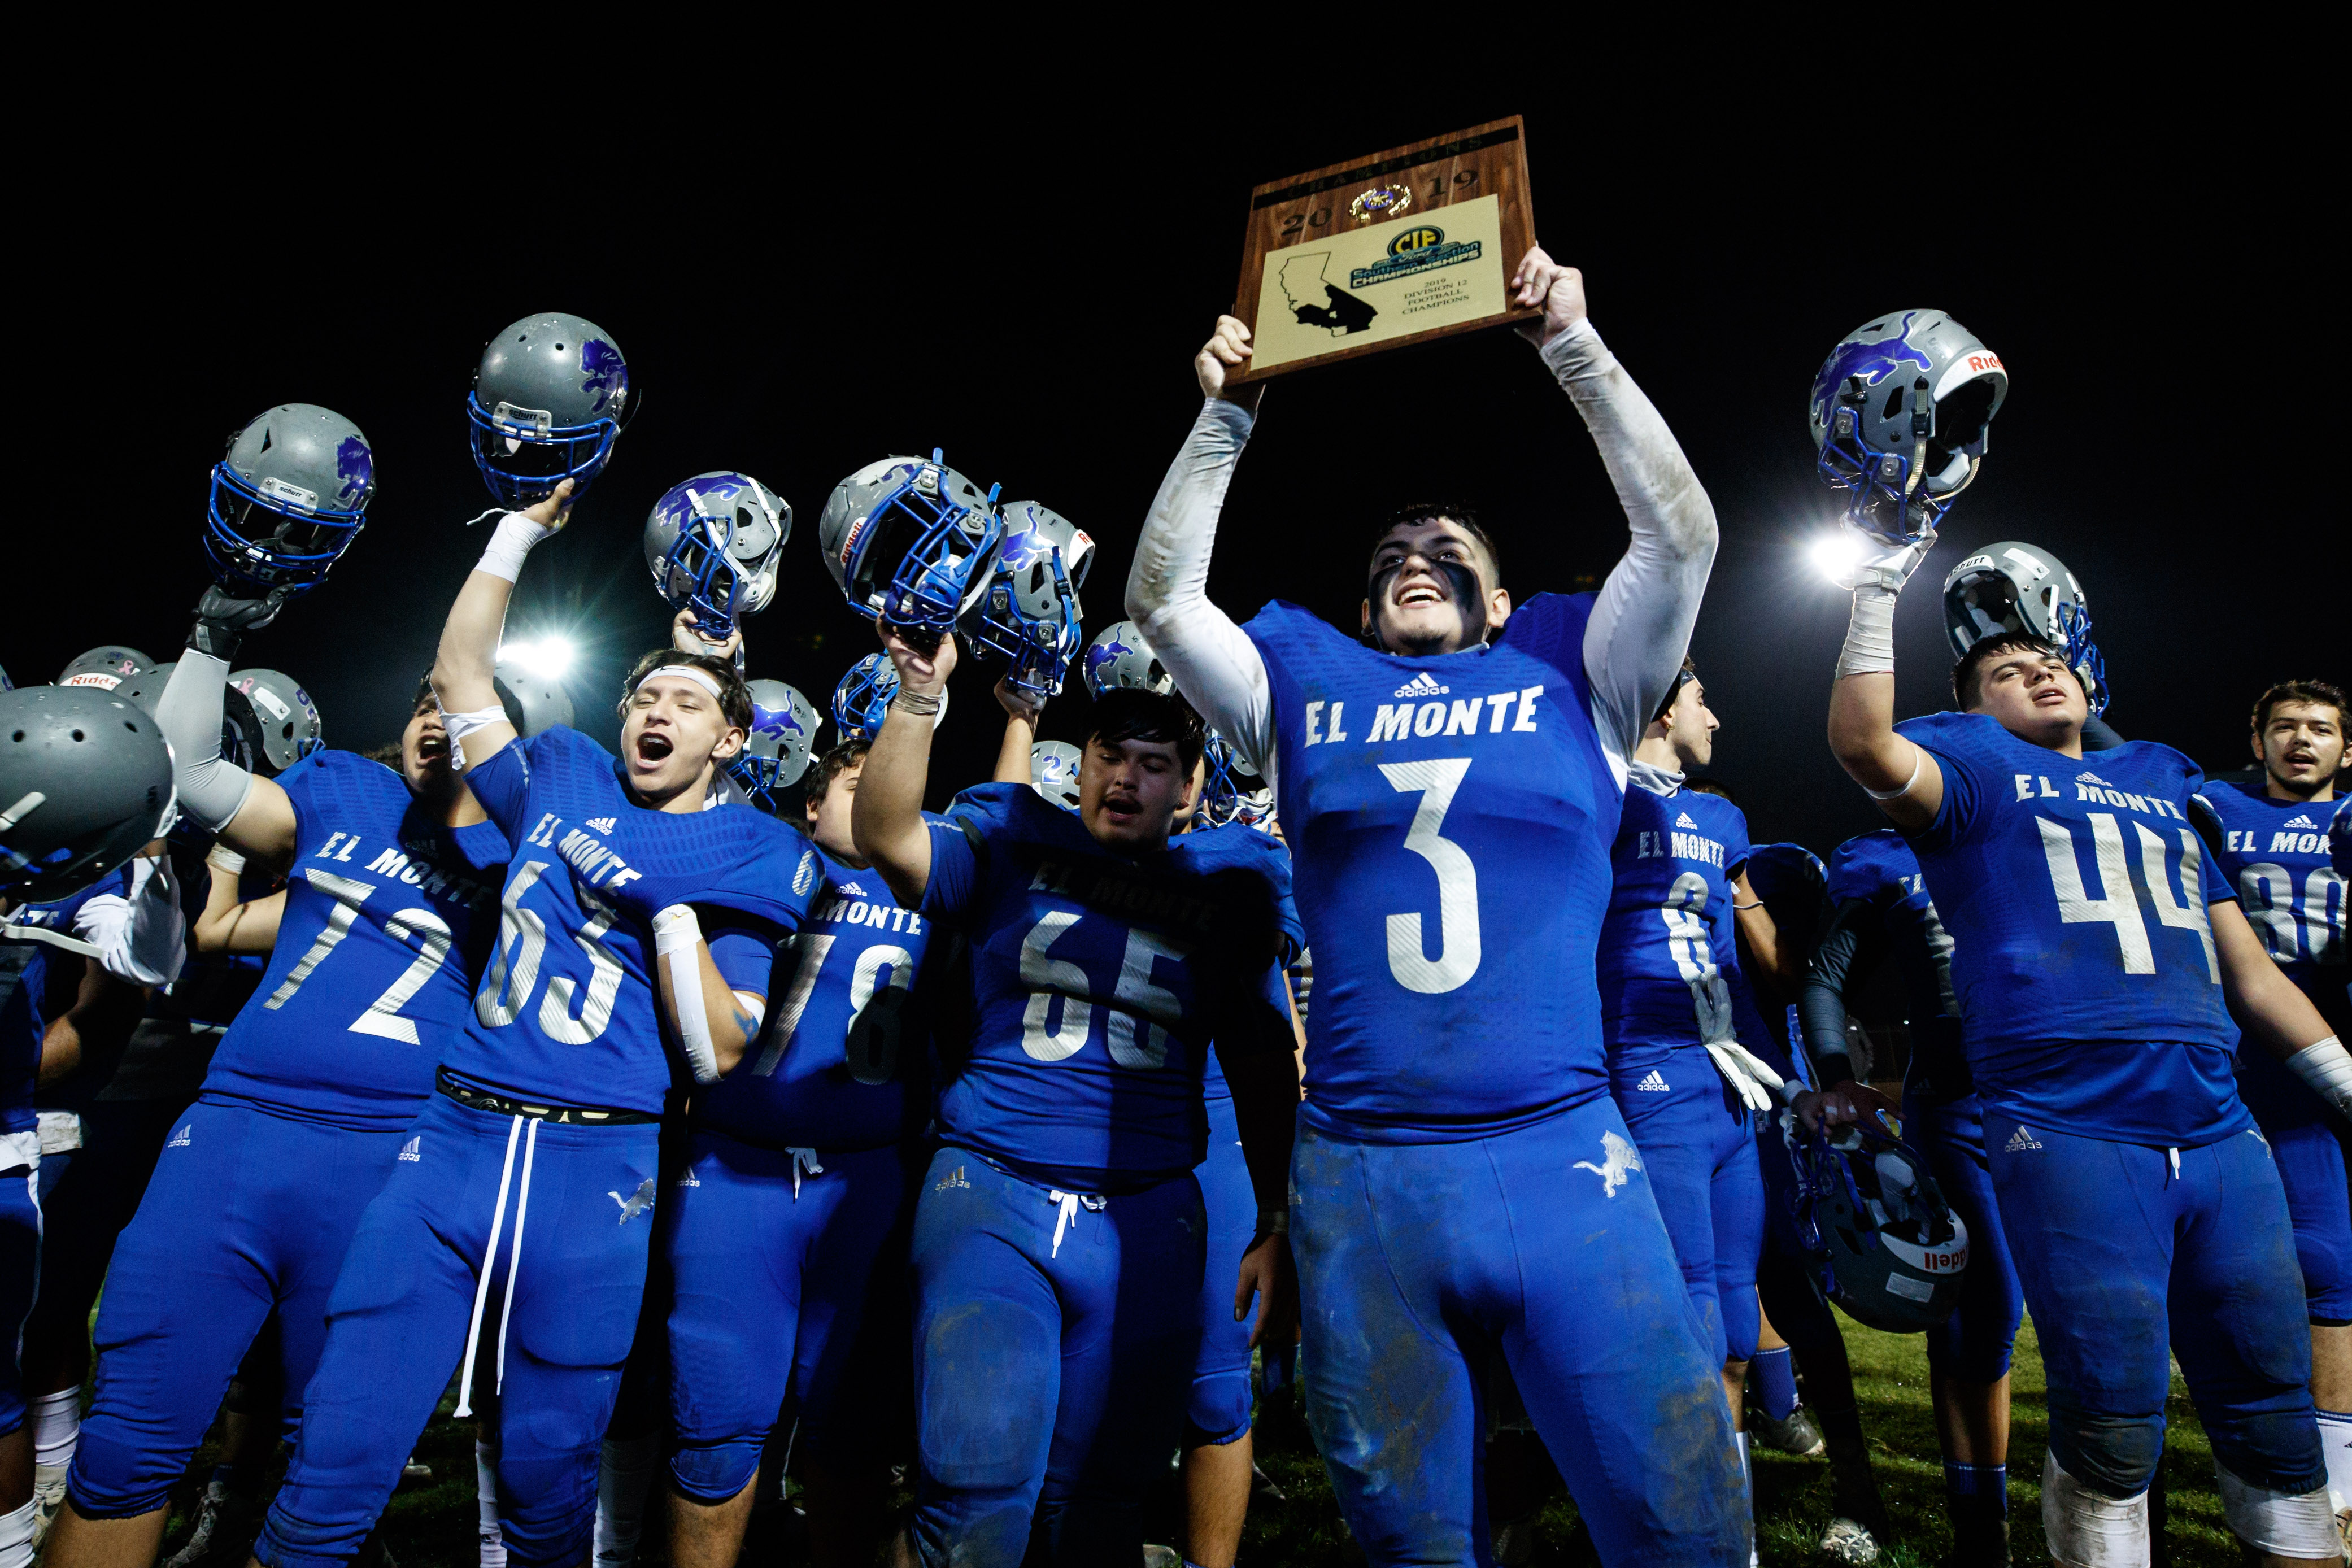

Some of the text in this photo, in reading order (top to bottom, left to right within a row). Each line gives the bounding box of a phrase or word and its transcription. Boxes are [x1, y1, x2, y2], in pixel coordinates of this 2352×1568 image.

[1287, 135, 1482, 198] CHAMPIONS
[1281, 171, 1478, 236] 20 19
[1395, 230, 1436, 254] CIF
[1353, 249, 1479, 287] CHAMPIONSHIPS
[1354, 243, 1478, 279] Southern Section
[1404, 283, 1453, 299] DIVISION
[1425, 278, 1446, 288] 2019
[1402, 295, 1470, 315] CHAMPIONS
[1408, 289, 1464, 306] FOOTBALL
[509, 409, 537, 420] schutt
[279, 486, 302, 498] schutt
[1394, 684, 1449, 698] adidas
[1305, 685, 1544, 748] EL MONTE
[2015, 774, 2187, 822] EL MONTE
[585, 819, 613, 835] adidas
[1676, 821, 1698, 830] adidas
[526, 812, 643, 897] EL MONTE
[1638, 831, 1664, 859] EL
[2227, 831, 2257, 852] EL
[315, 831, 494, 913] EL MONTE
[1378, 757, 1482, 994] 3
[835, 888, 868, 896] adidas
[2035, 813, 2221, 985] 44
[813, 899, 922, 935] MONTE
[263, 868, 452, 1045] 72
[750, 932, 913, 1085] 78
[1637, 1083, 1670, 1091] adidas
[2005, 1139, 2042, 1152] adidas
